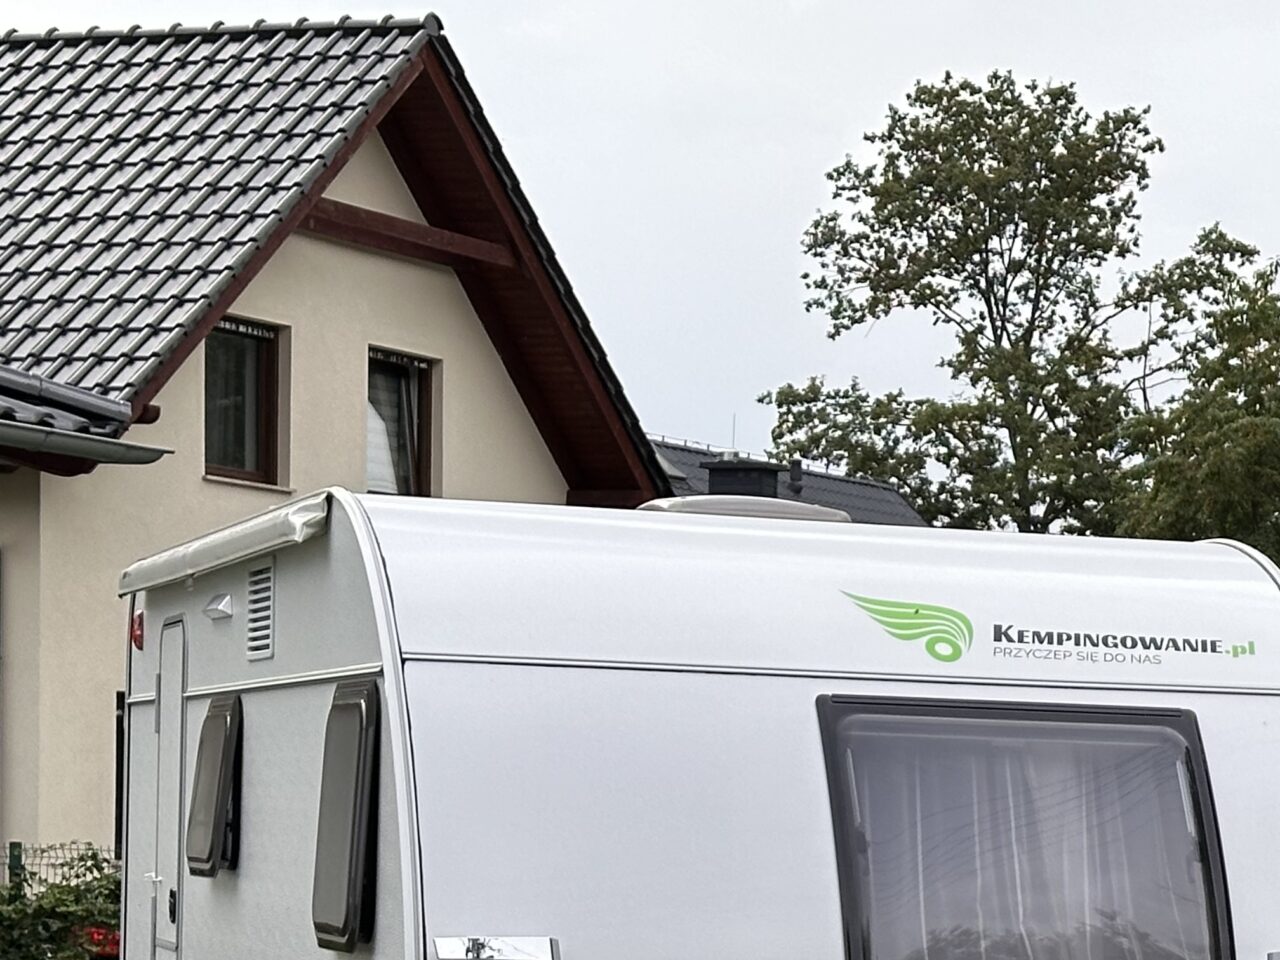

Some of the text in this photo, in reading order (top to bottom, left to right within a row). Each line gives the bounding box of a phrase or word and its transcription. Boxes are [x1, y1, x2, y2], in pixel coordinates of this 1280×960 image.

[993, 646, 1072, 660] PRZYCZEP
[1103, 652, 1126, 663] DO
[1130, 653, 1162, 665] NAS
